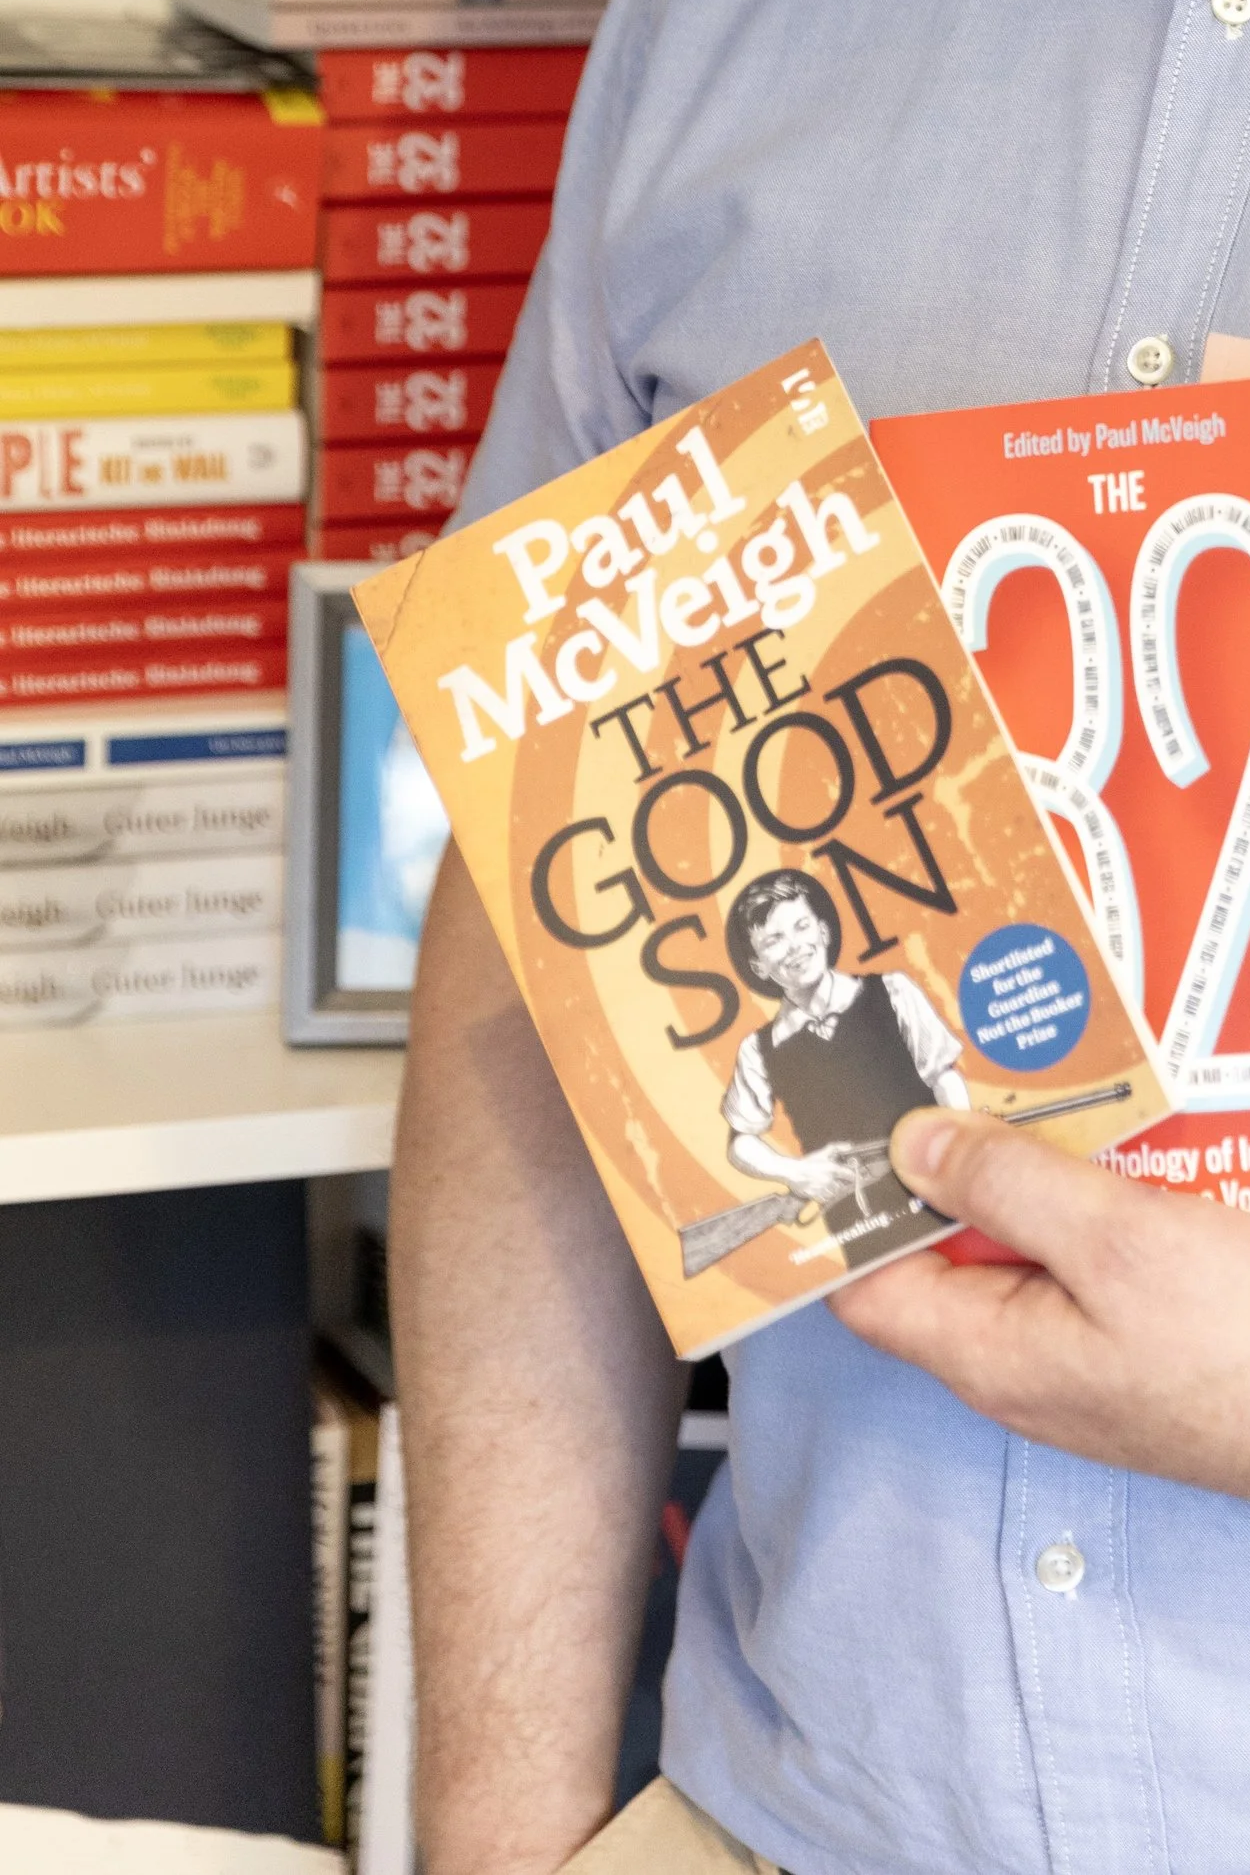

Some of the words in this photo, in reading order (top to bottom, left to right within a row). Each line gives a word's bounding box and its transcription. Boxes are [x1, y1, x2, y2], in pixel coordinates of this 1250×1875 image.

[1003, 427, 1064, 459] Edited
[1066, 426, 1092, 457] by
[1094, 421, 1138, 452] Paul
[1140, 410, 1228, 448] McVeigh
[1086, 469, 1147, 515] THE
[493, 426, 747, 624] Paul
[438, 480, 880, 763] McVeigh
[589, 630, 813, 784] THE
[530, 656, 954, 950] GOOD
[638, 792, 958, 1051] SON
[970, 936, 1055, 983] Shortlisted
[992, 977, 1016, 996] for
[1015, 965, 1044, 987] the
[977, 1021, 1007, 1044] Not
[1004, 1013, 1032, 1033] the
[1029, 991, 1083, 1023] Booker
[987, 980, 1061, 1018] Guardian
[1016, 1023, 1058, 1051] Prize
[1092, 1142, 1200, 1185] thology
[1204, 1139, 1236, 1173] of
